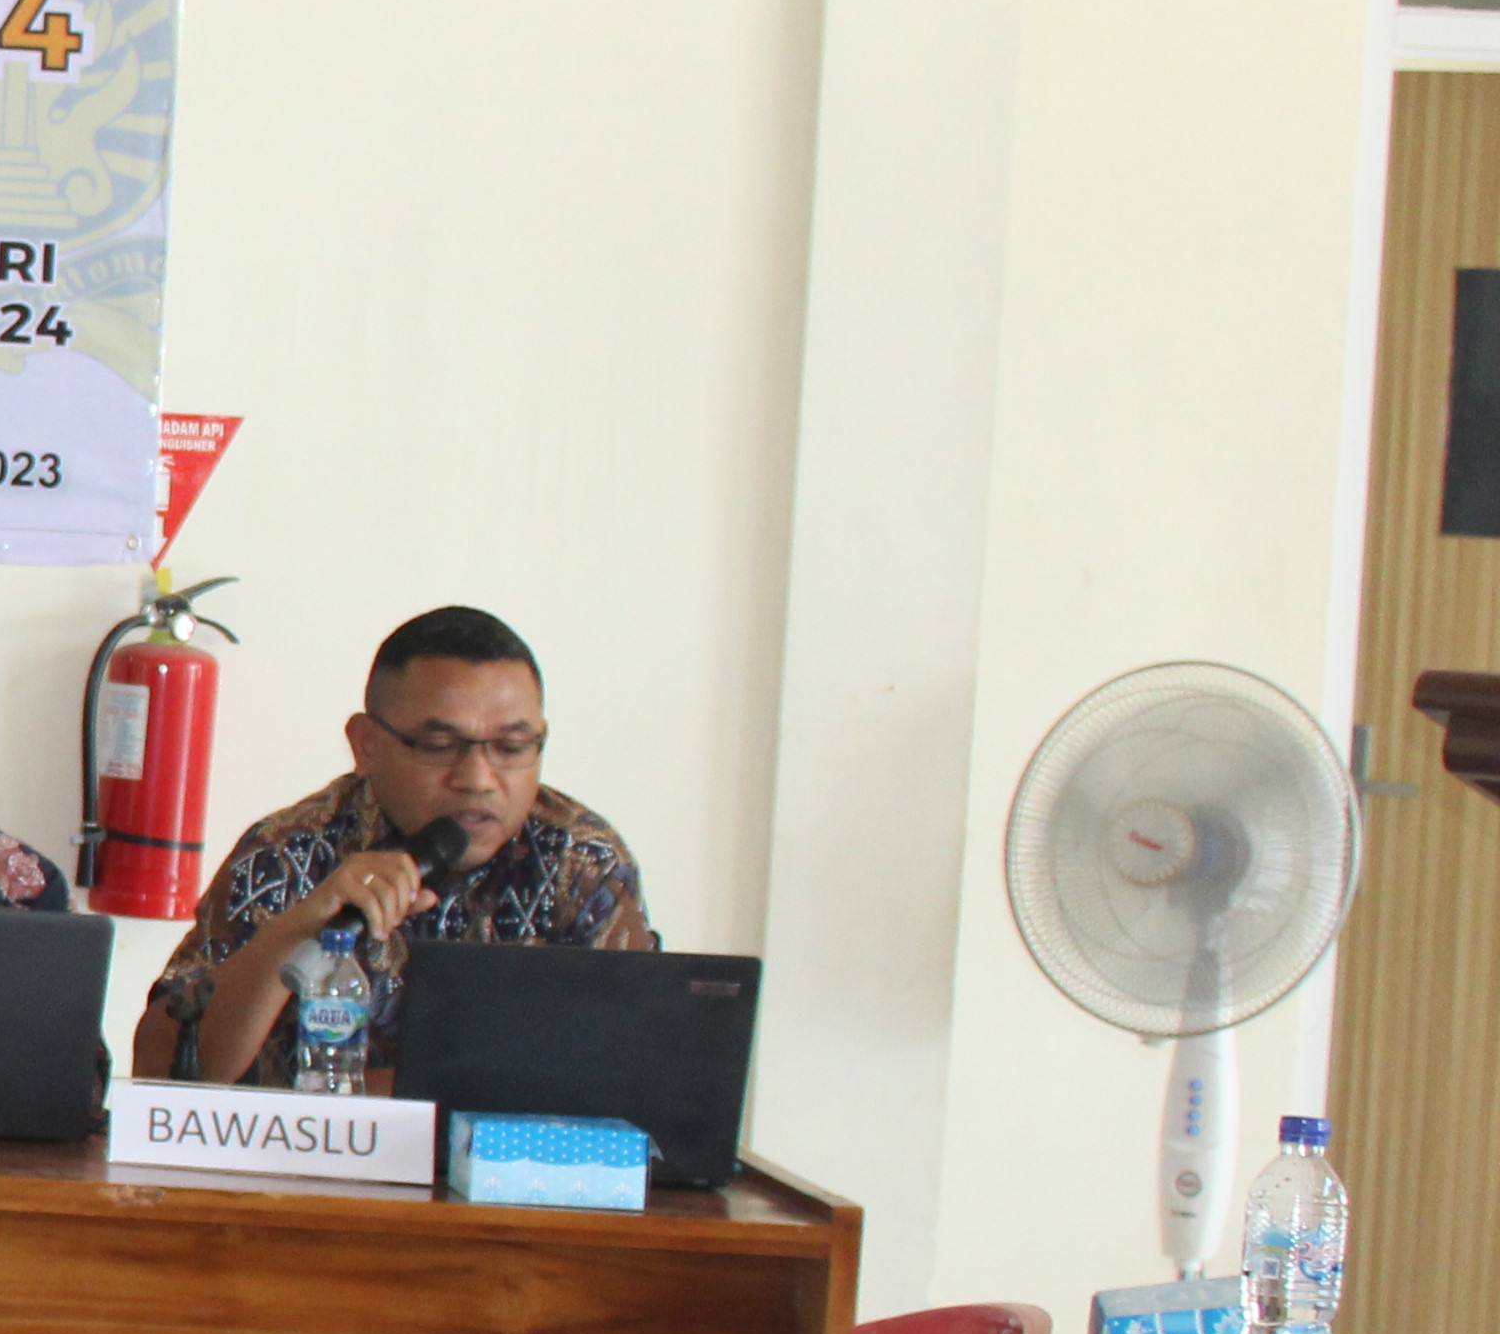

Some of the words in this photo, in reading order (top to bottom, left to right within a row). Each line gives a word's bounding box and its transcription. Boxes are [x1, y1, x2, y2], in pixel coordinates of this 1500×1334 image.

[202, 422, 225, 438] API
[308, 1008, 351, 1026] AQUA
[148, 1106, 379, 1157] BAWASLU
